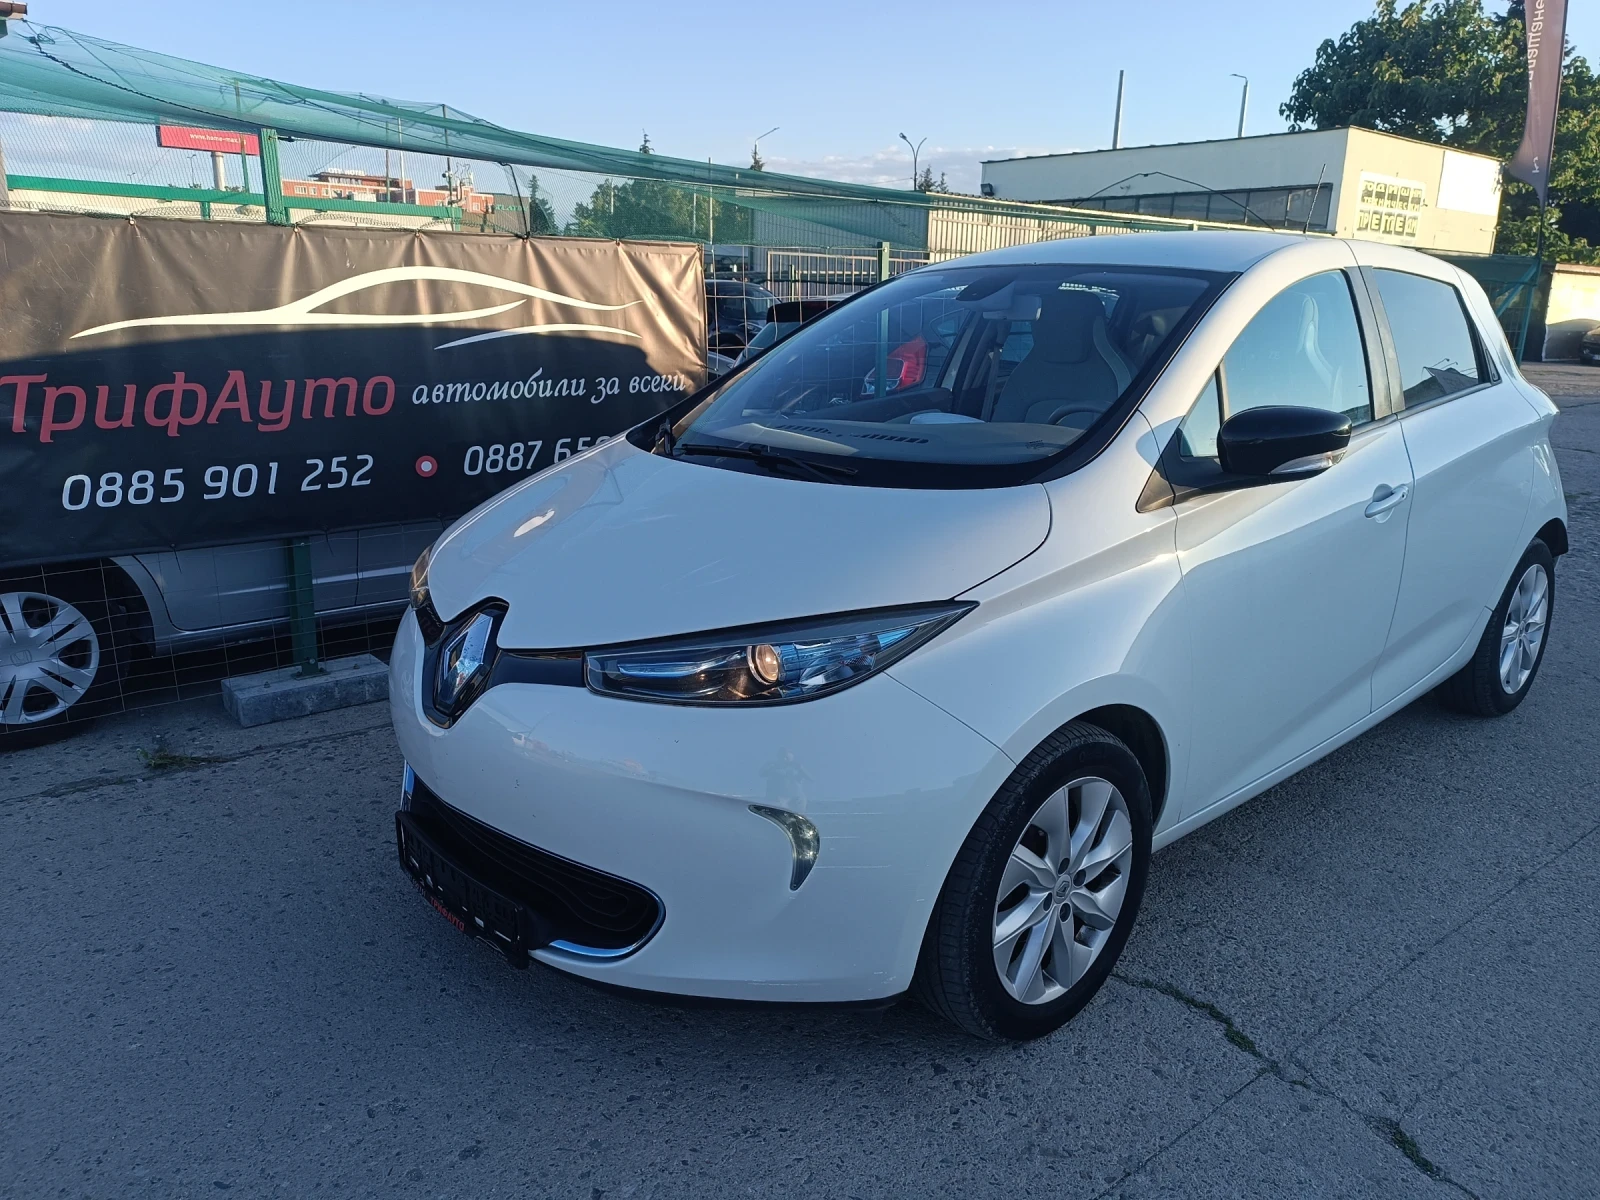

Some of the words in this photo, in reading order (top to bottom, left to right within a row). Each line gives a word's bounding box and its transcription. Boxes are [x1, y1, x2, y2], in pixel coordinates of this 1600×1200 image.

[0, 370, 396, 443] ТрифАуто
[412, 367, 587, 405] автомобили
[590, 377, 620, 404] за
[629, 372, 687, 394] всеки
[61, 468, 185, 511] 0885
[203, 462, 279, 500] 901
[300, 454, 374, 492] 252
[463, 440, 543, 476] 0887
[553, 435, 612, 464] 65
